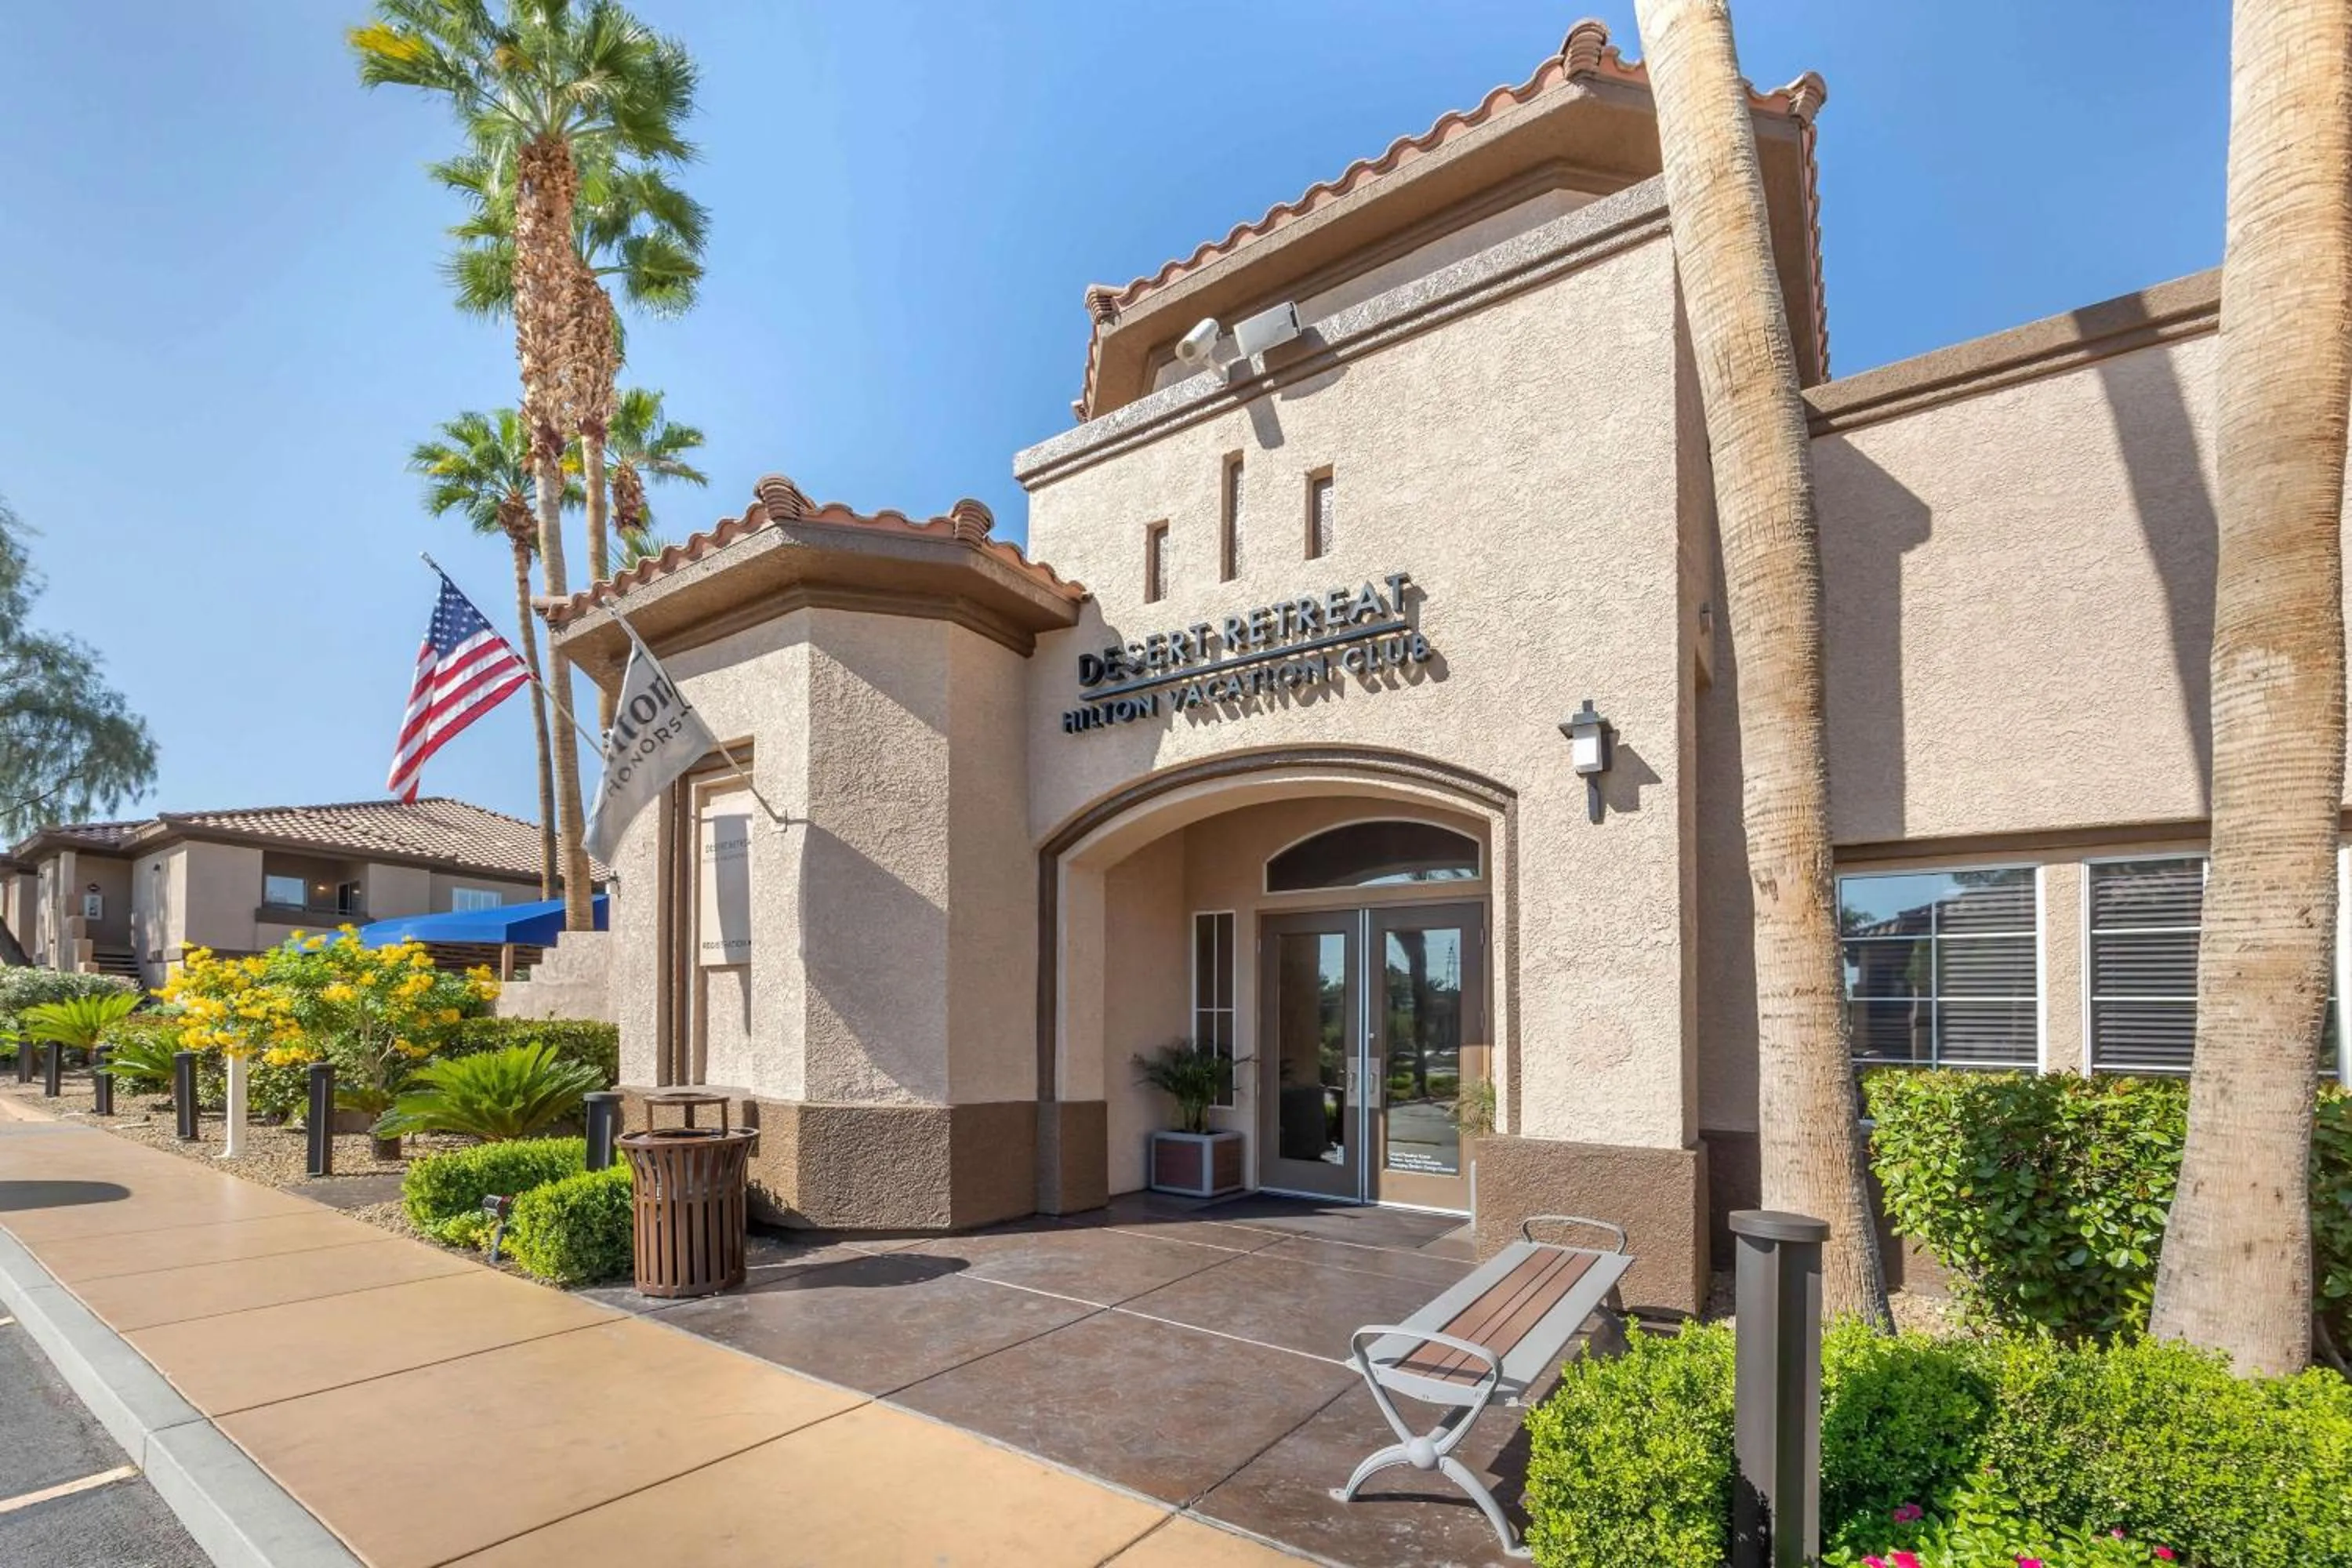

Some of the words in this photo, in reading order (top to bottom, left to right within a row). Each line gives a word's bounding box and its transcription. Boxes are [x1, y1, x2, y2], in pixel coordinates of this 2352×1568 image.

[1079, 622, 1211, 687] DESERT
[1222, 572, 1410, 650] RETREAT
[1062, 694, 1159, 734] HILTON
[1165, 655, 1330, 712] VACATION
[1342, 633, 1431, 675] CLUB
[607, 717, 682, 797] HONORS
